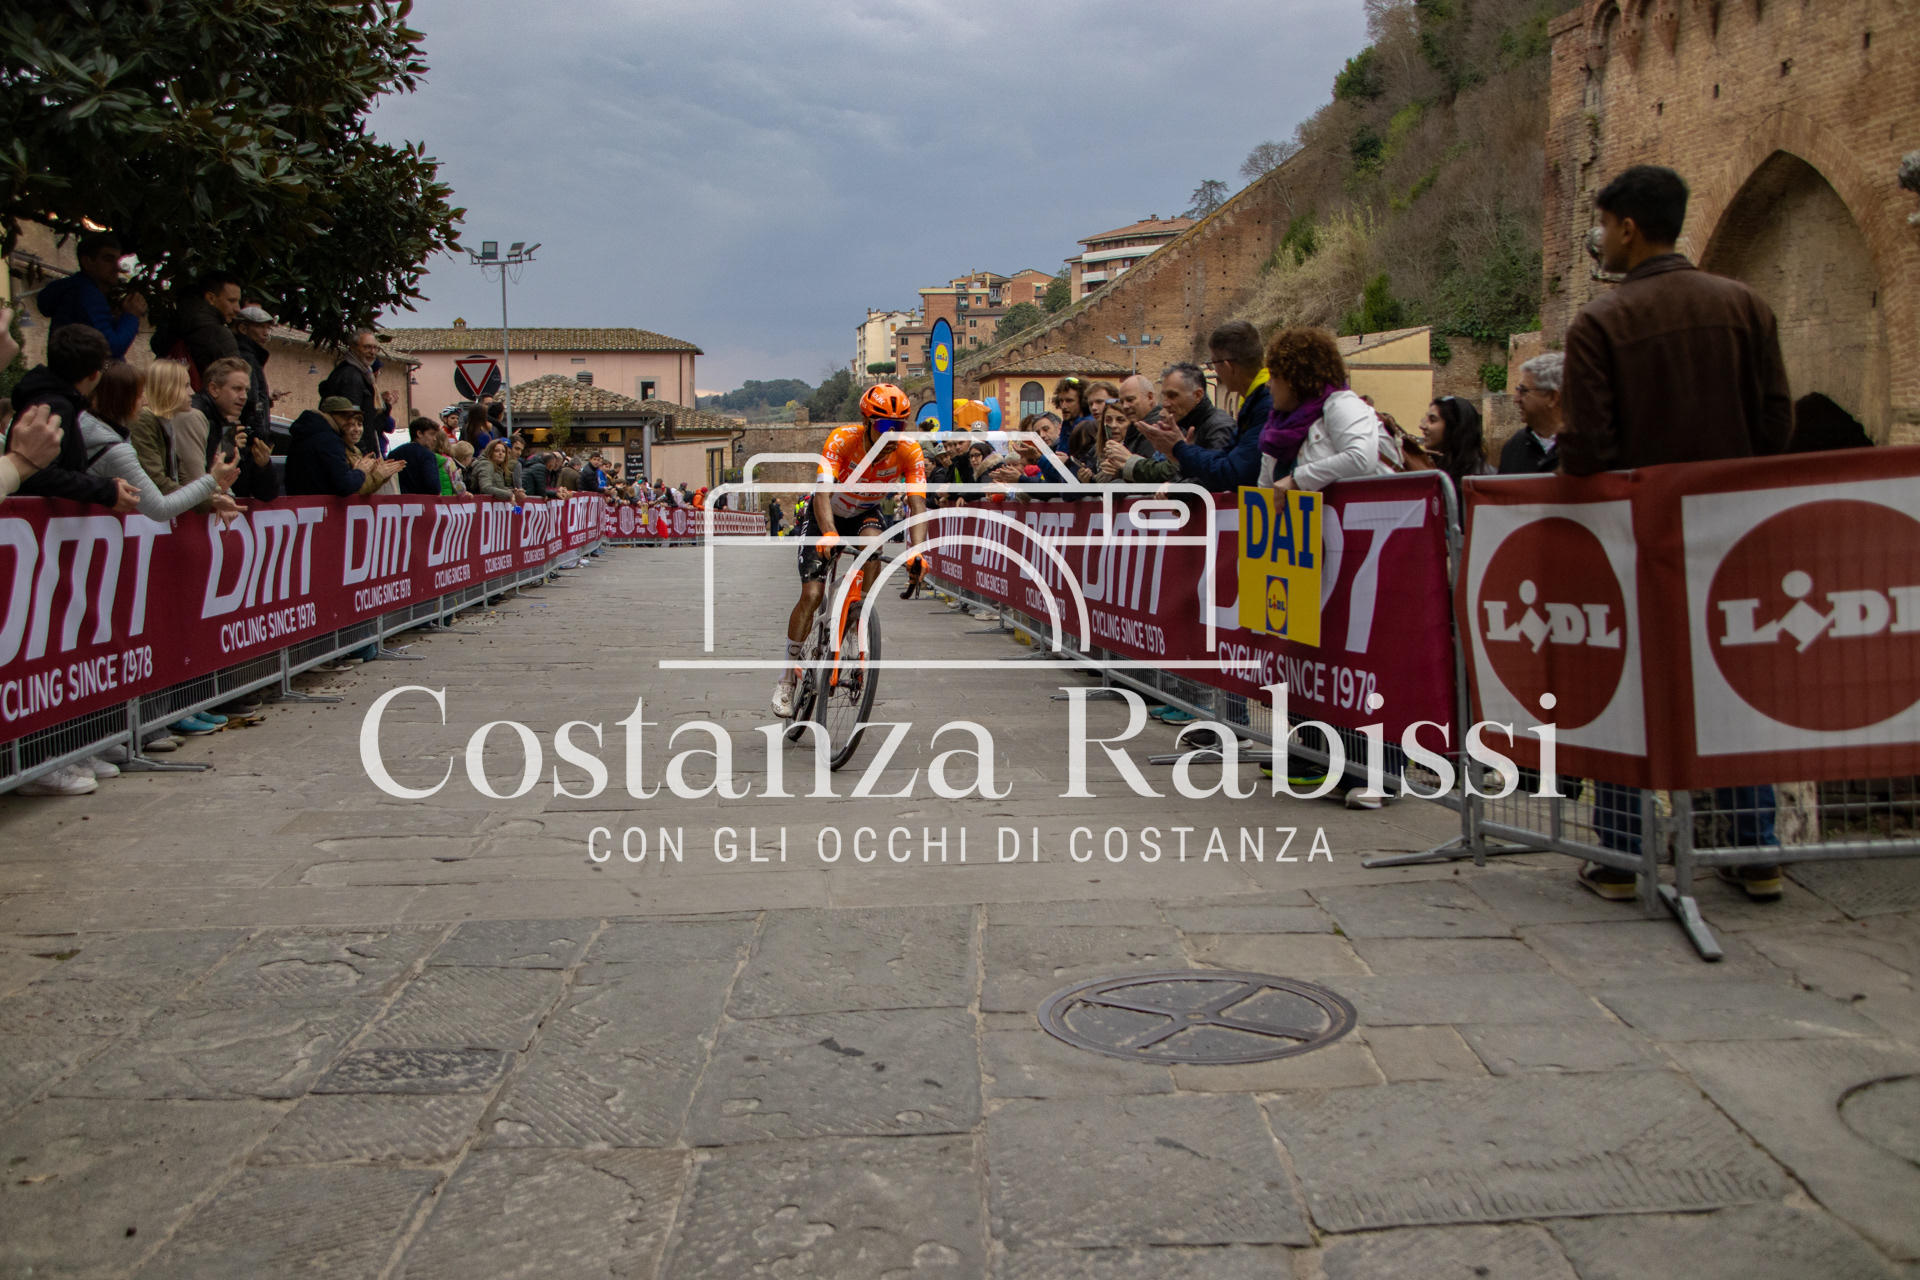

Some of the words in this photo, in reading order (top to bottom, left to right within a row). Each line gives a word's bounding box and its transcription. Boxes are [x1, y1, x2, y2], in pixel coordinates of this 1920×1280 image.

[201, 506, 325, 620] DMT
[343, 504, 423, 586] DMT
[428, 503, 476, 567] DMT
[480, 502, 514, 556] DMT
[971, 510, 1016, 573] DMT
[1020, 511, 1074, 591] DMT
[1082, 511, 1180, 616] DMT
[1244, 490, 1314, 569] DAI
[355, 585, 382, 612] CYCLING
[383, 580, 399, 604] SINCE
[400, 578, 411, 599] 1978
[1197, 498, 1426, 654] DT
[221, 611, 267, 653] CYCLING
[269, 606, 297, 637] SINCE
[297, 602, 317, 630] 1978
[1092, 609, 1120, 641] CYCLING
[1121, 617, 1145, 649] SINCE
[1145, 623, 1166, 655] 1978
[0, 668, 63, 723] CLING
[68, 653, 118, 702] SINCE
[122, 645, 154, 685] 1978
[1218, 640, 1273, 687] CYCLING
[1276, 654, 1326, 703] SINCE
[1331, 665, 1376, 715] 1978
